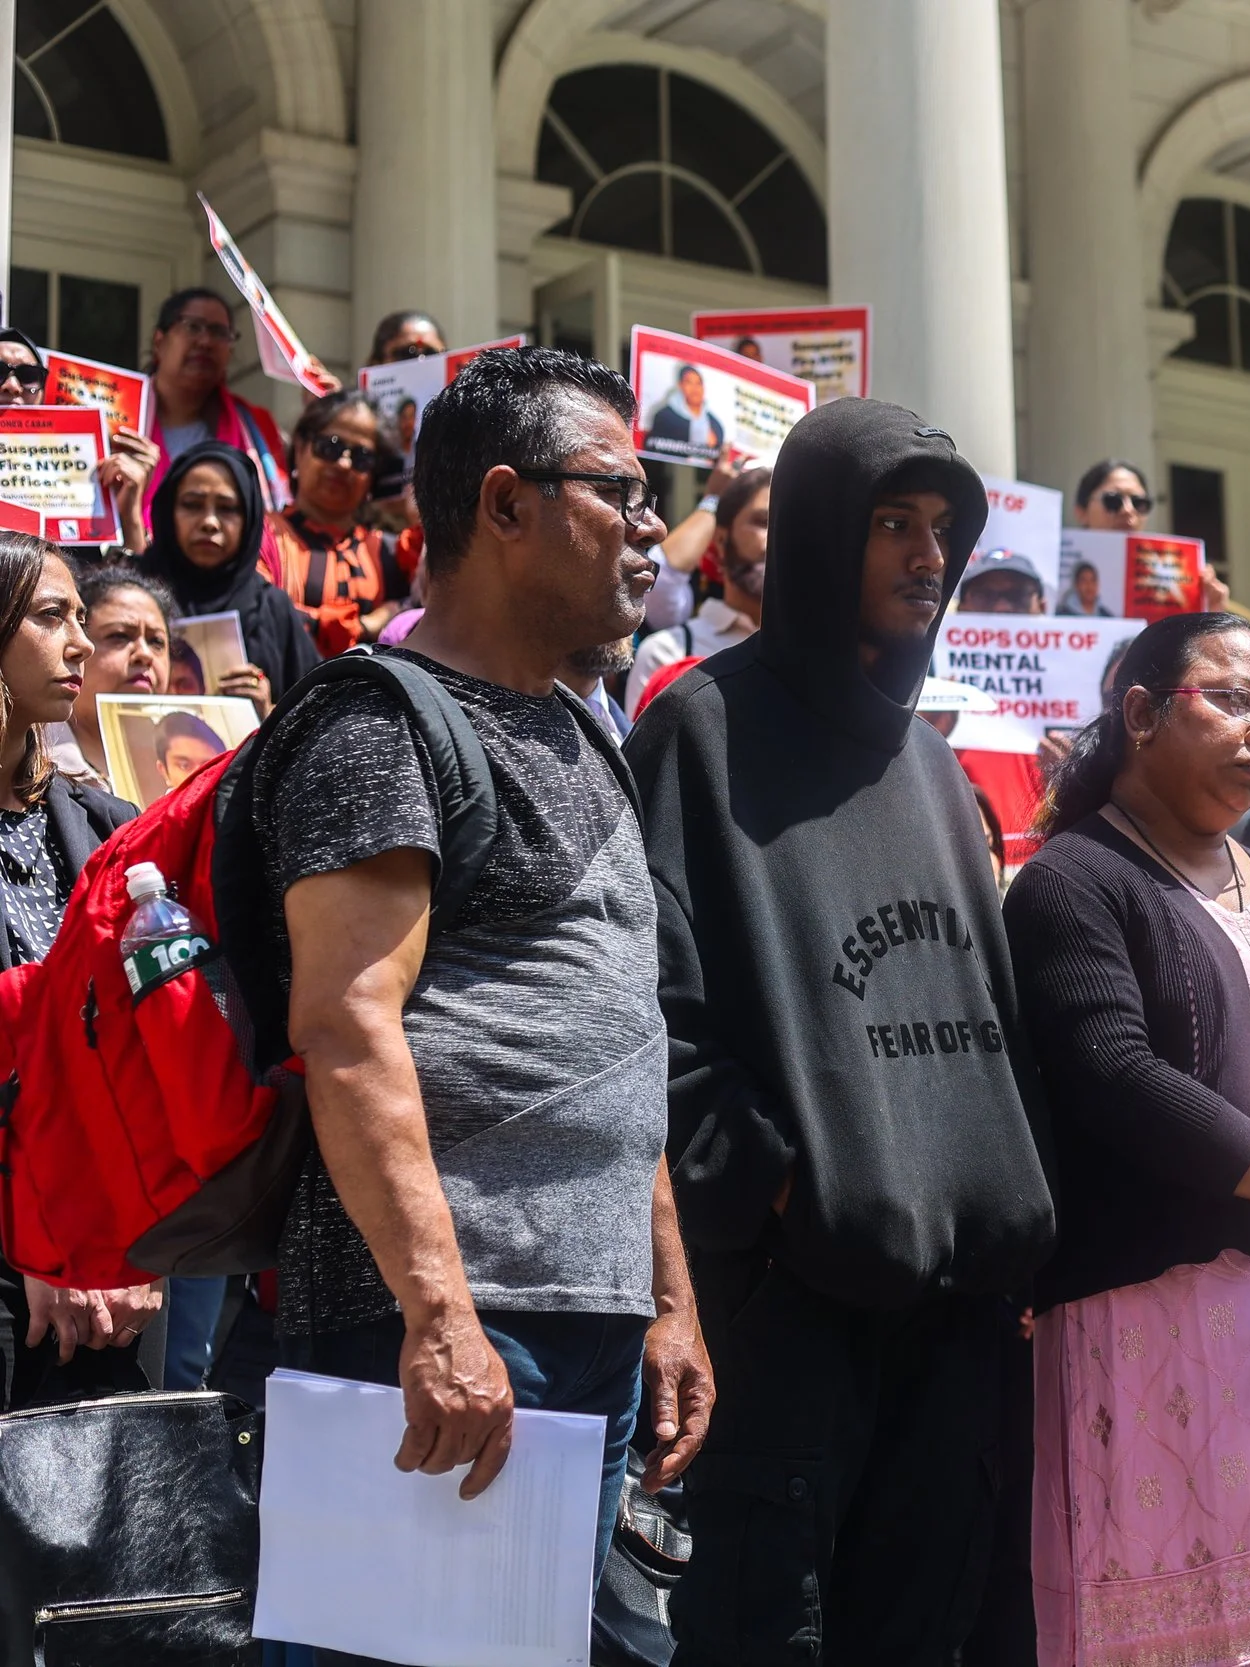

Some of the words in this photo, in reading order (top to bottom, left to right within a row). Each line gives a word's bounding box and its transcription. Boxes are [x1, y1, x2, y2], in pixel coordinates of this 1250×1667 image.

[36, 460, 87, 471] NYPD
[946, 627, 1011, 648] COPS
[1016, 631, 1066, 649] OUT
[1068, 633, 1098, 650] OF
[948, 652, 1046, 672] MENTAL
[975, 698, 1079, 720] PONSE
[866, 1021, 935, 1058] FEAR
[935, 1020, 971, 1053] OF
